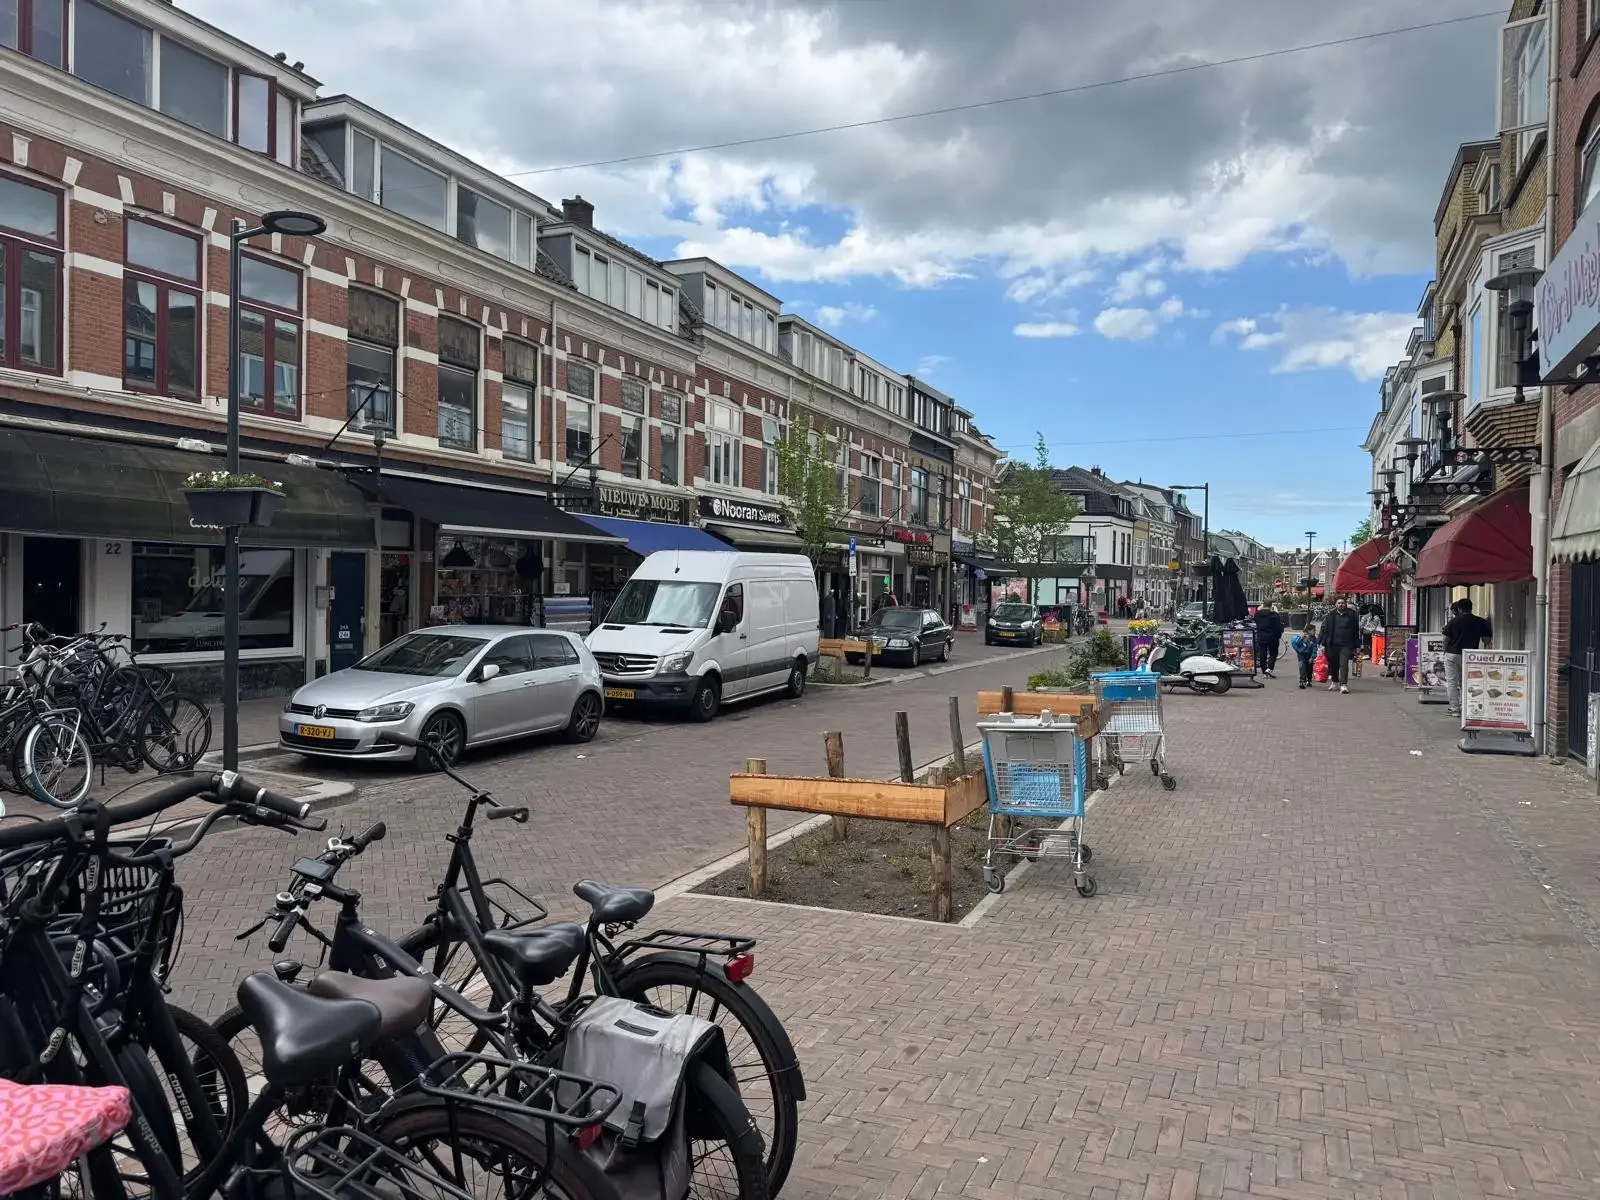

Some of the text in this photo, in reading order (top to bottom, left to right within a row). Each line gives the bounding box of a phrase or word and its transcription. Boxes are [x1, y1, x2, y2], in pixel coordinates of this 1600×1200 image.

[599, 487, 680, 512] NIEUWE MODE
[722, 499, 758, 520] Nooran
[105, 543, 121, 555] 22
[188, 565, 248, 589] delue
[1468, 653, 1524, 663] Oued Amlil
[300, 726, 331, 738] R-320-VJ
[168, 1072, 194, 1120] CORTEGO
